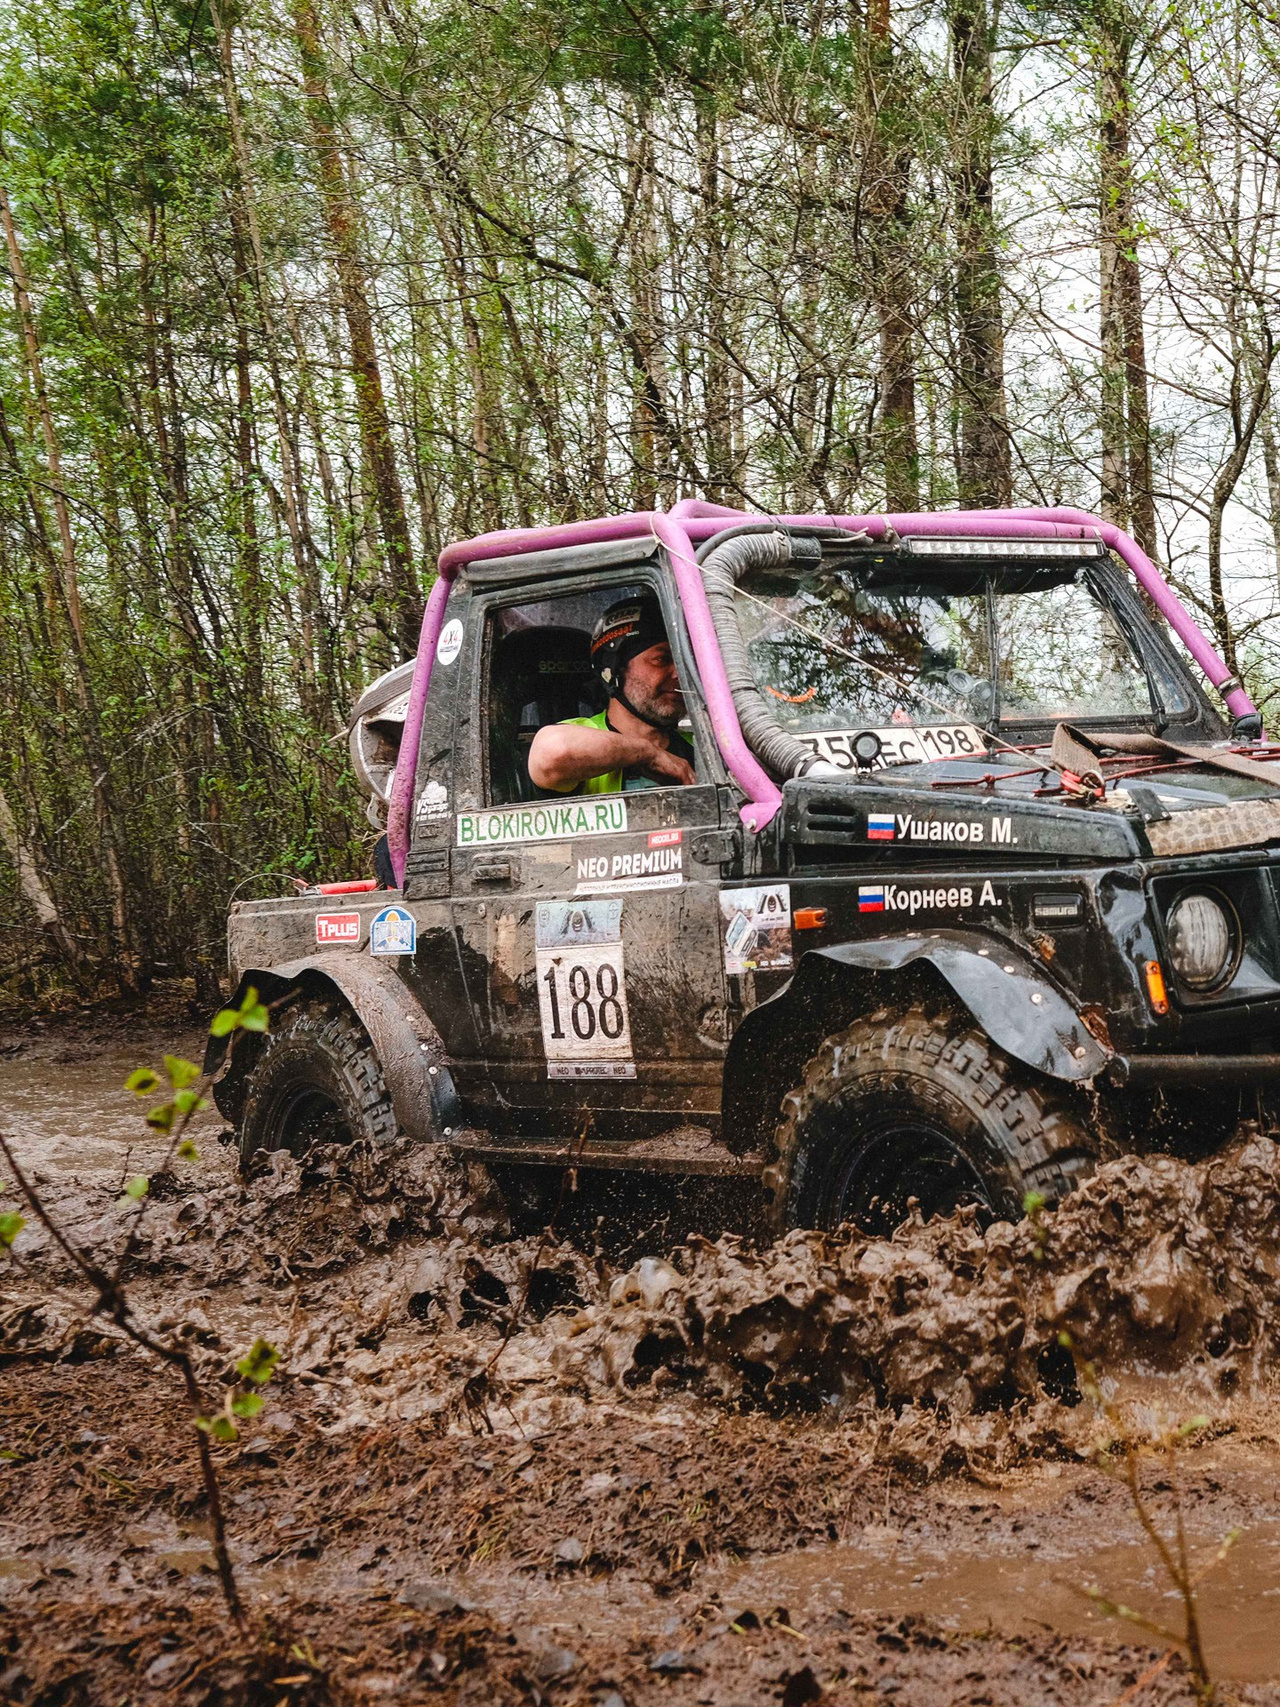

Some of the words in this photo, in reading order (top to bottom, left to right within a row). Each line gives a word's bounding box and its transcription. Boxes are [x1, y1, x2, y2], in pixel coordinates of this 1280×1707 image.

[923, 729, 975, 755] 198
[461, 803, 623, 842] BLOKIROVKA.RU
[896, 814, 984, 843] Ушаков
[991, 817, 1018, 844] М.
[577, 856, 609, 879] NEO
[611, 847, 683, 876] PREMIUM
[884, 884, 973, 915] Корнеев
[979, 880, 1003, 907] А.
[543, 963, 624, 1040] 188
